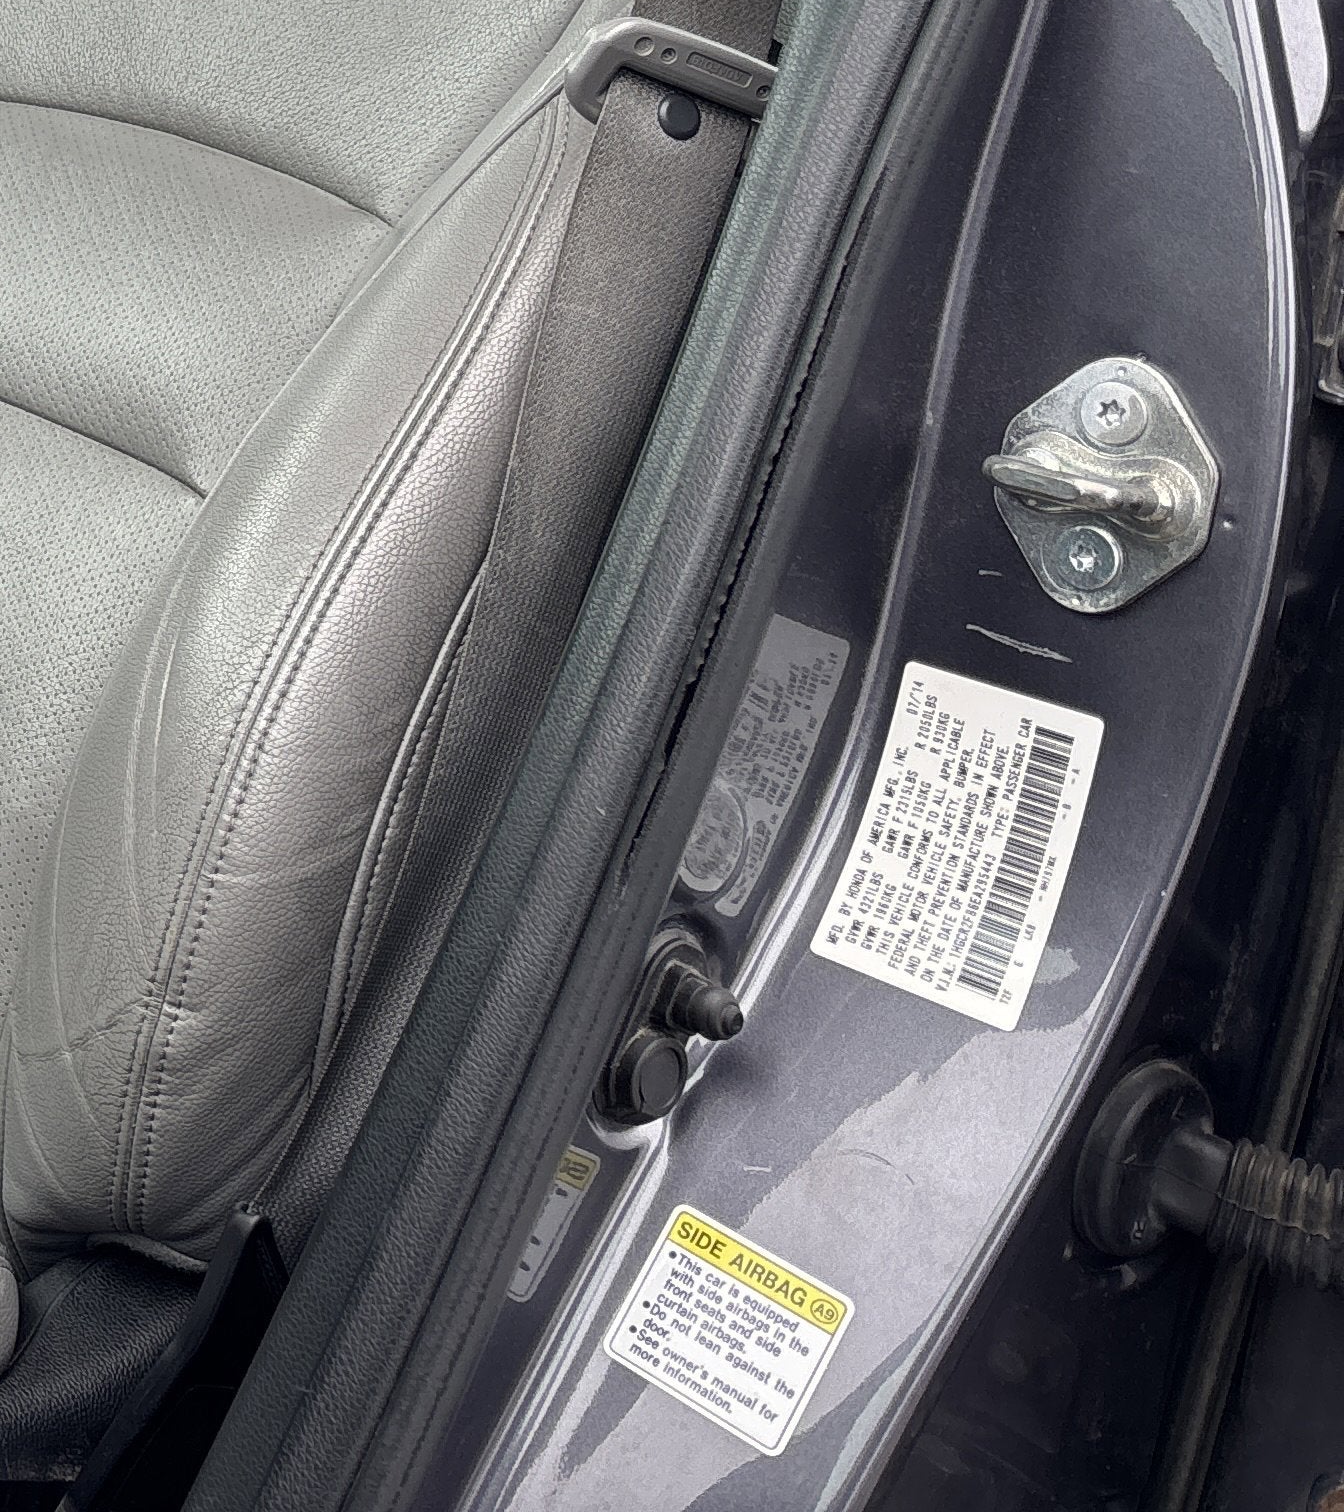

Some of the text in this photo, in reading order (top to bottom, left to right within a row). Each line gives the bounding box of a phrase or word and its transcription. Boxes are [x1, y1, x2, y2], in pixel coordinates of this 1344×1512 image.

[931, 711, 951, 744] 930KG
[928, 746, 942, 756] R
[990, 806, 1010, 838] TYPE:
[1001, 742, 1027, 802] PASSENGER
[1017, 716, 1033, 739] CAR
[844, 694, 938, 944] GVWR 4321LBS GAWR F 2315LBS R 2050LBS
[979, 783, 1000, 818] SHOWN
[866, 802, 891, 847] AMERICA
[874, 717, 966, 956] THIS VEHICLE CONFORMS TO ALL APPLICABLE
[896, 833, 916, 860] GAWR
[906, 820, 919, 830] F
[859, 849, 874, 864] OF
[903, 728, 996, 977] AND THEFT PREVENTION STANDARDS IN EFFECT
[955, 821, 989, 893] MANUFACTURE
[845, 868, 868, 900] HONDA
[887, 928, 916, 970] FEDERAL
[906, 890, 930, 923] MOTOR
[920, 840, 947, 886] VEHICLE
[948, 895, 963, 911] OF
[837, 901, 853, 917] BY
[936, 913, 958, 942] DATE
[860, 924, 881, 951] GVWR
[926, 943, 946, 964] THE
[919, 967, 936, 983] ON
[677, 1221, 838, 1323] SIDE AIRBAG A9
[677, 1252, 800, 1333] This car is equipped
[642, 1317, 671, 1342] door.
[656, 1293, 746, 1355] curtain airbags.
[663, 1277, 782, 1358] front seats and side
[669, 1267, 810, 1357] with side airbags in the
[648, 1302, 795, 1400] Do not lean against the
[628, 1342, 732, 1414] more information.
[636, 1328, 779, 1423] See owner's manual for
